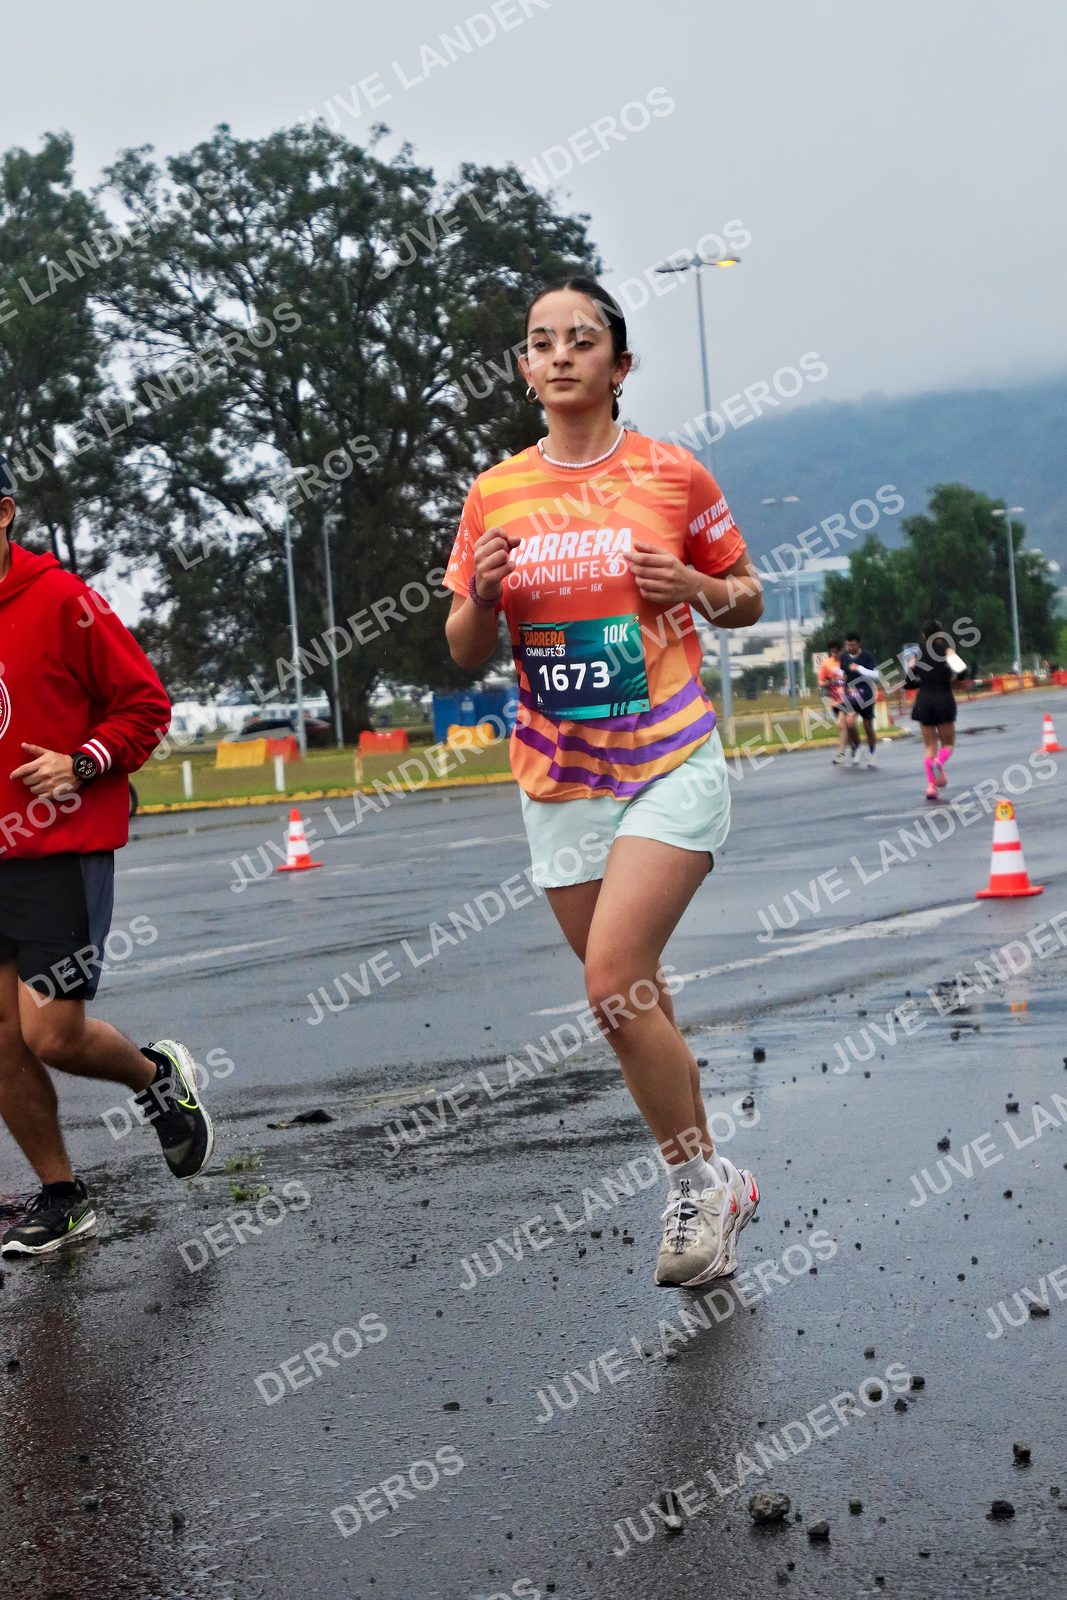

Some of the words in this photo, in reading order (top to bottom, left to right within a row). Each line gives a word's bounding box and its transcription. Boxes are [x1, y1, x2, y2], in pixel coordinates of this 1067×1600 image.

[509, 527, 631, 567] CARRERA
[507, 560, 600, 590] OMNILIFE
[559, 585, 572, 596] 10K
[523, 630, 566, 646] CARRERA
[602, 623, 630, 645] 10K
[538, 661, 611, 691] 1673
